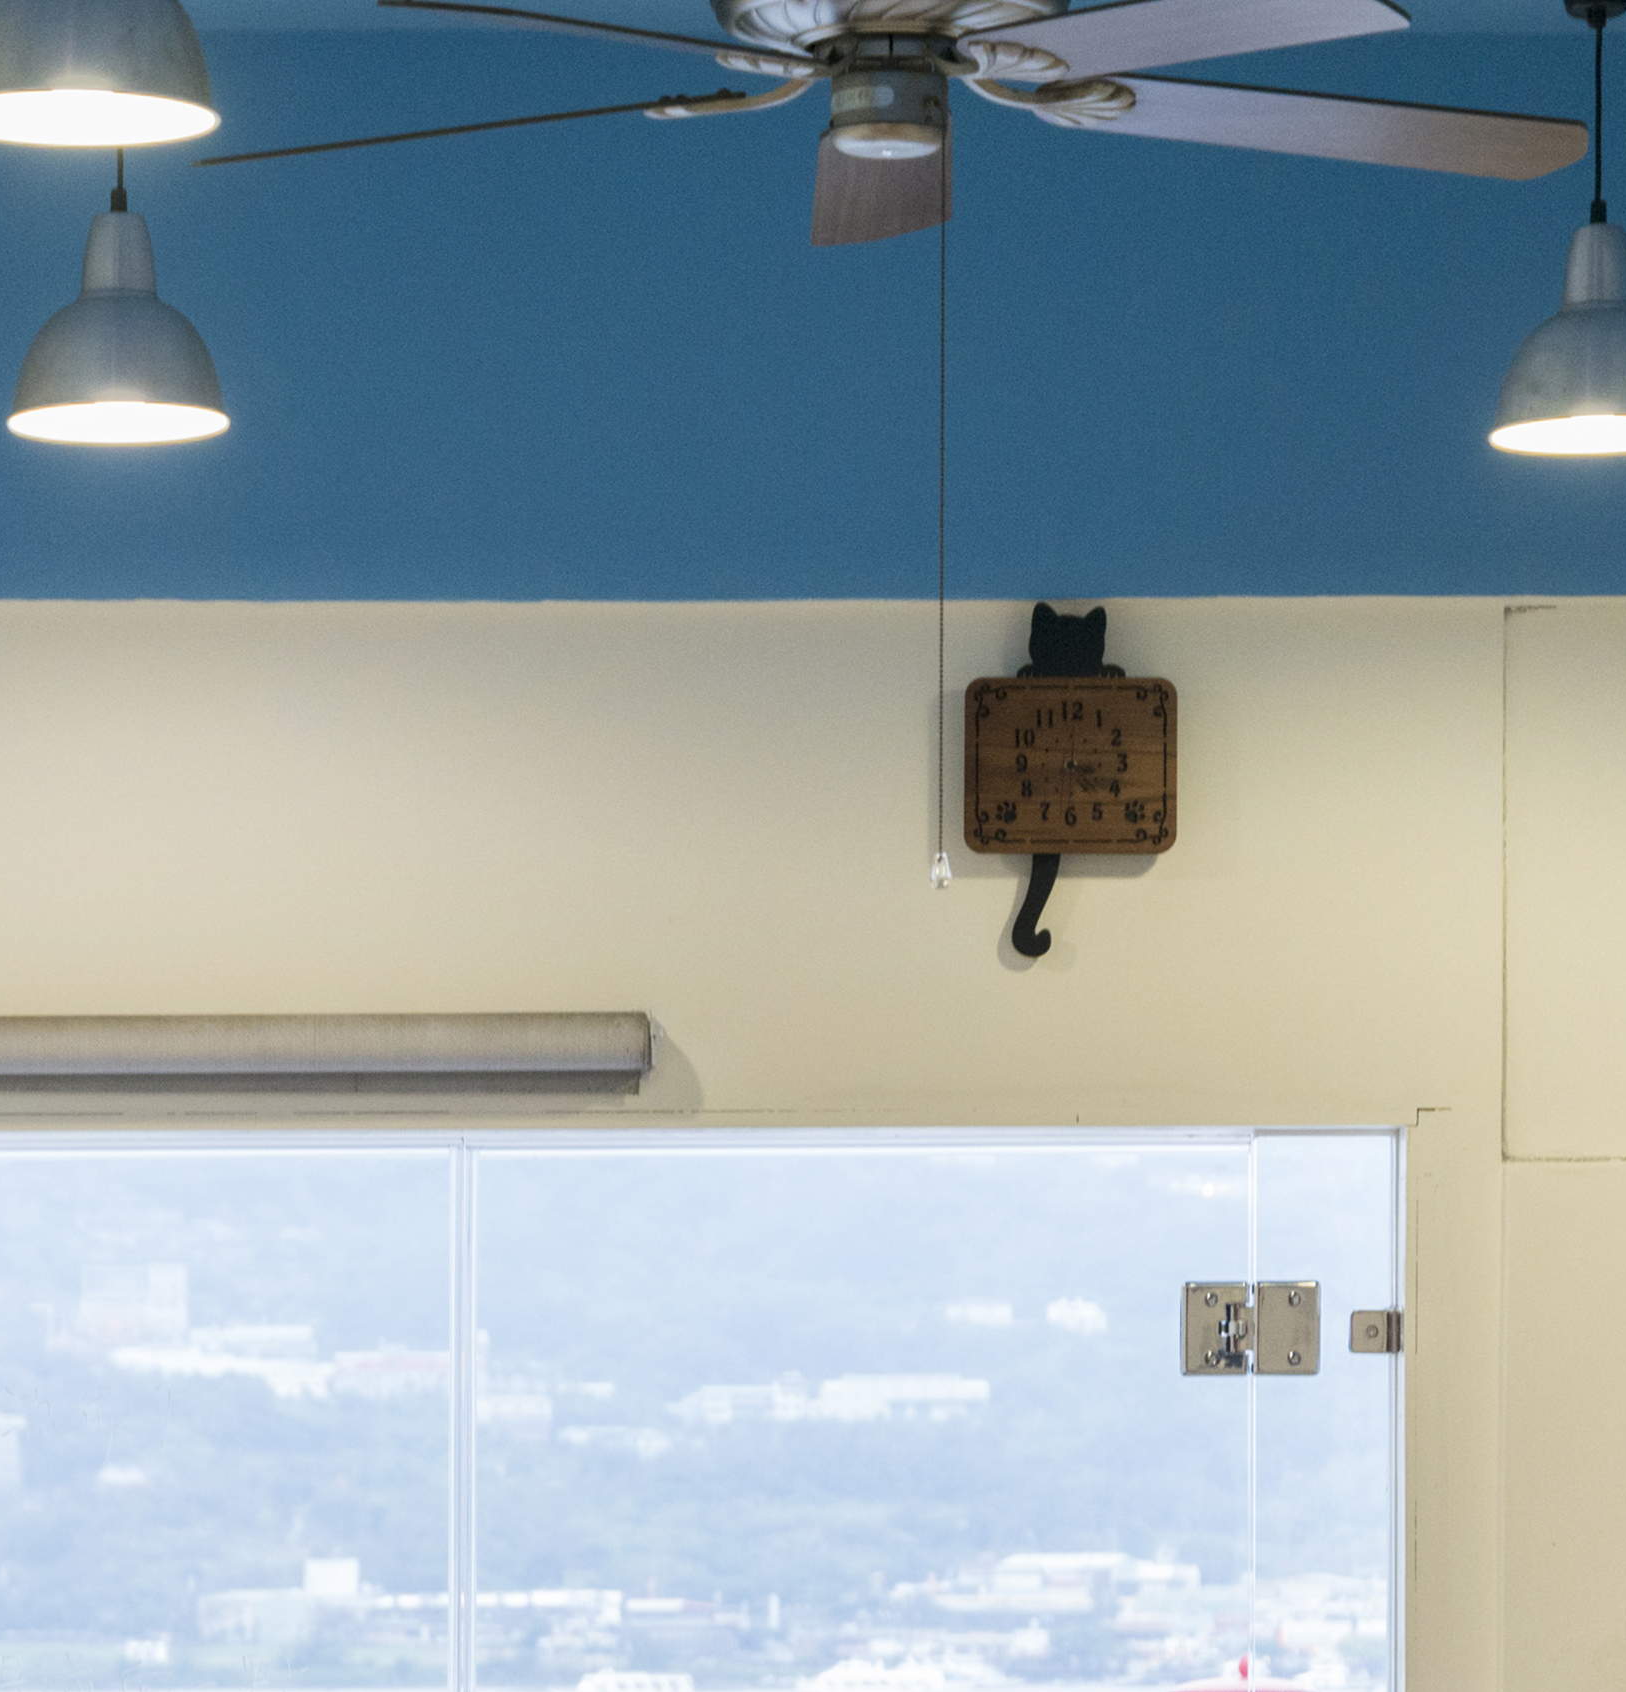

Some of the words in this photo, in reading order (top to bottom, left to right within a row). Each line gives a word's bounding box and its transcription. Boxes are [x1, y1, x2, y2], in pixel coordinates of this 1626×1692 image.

[1035, 708, 1055, 729] 11
[1060, 700, 1084, 721] 12
[1094, 709, 1104, 728] 1
[1014, 728, 1035, 748] 10
[1110, 728, 1123, 747] 2
[1015, 753, 1029, 773] 9
[1116, 753, 1129, 774] 3
[1020, 779, 1033, 798] 8
[1108, 780, 1122, 798] 4
[1039, 802, 1052, 821] 7
[1064, 807, 1078, 827] 6
[1091, 802, 1104, 821] 5
